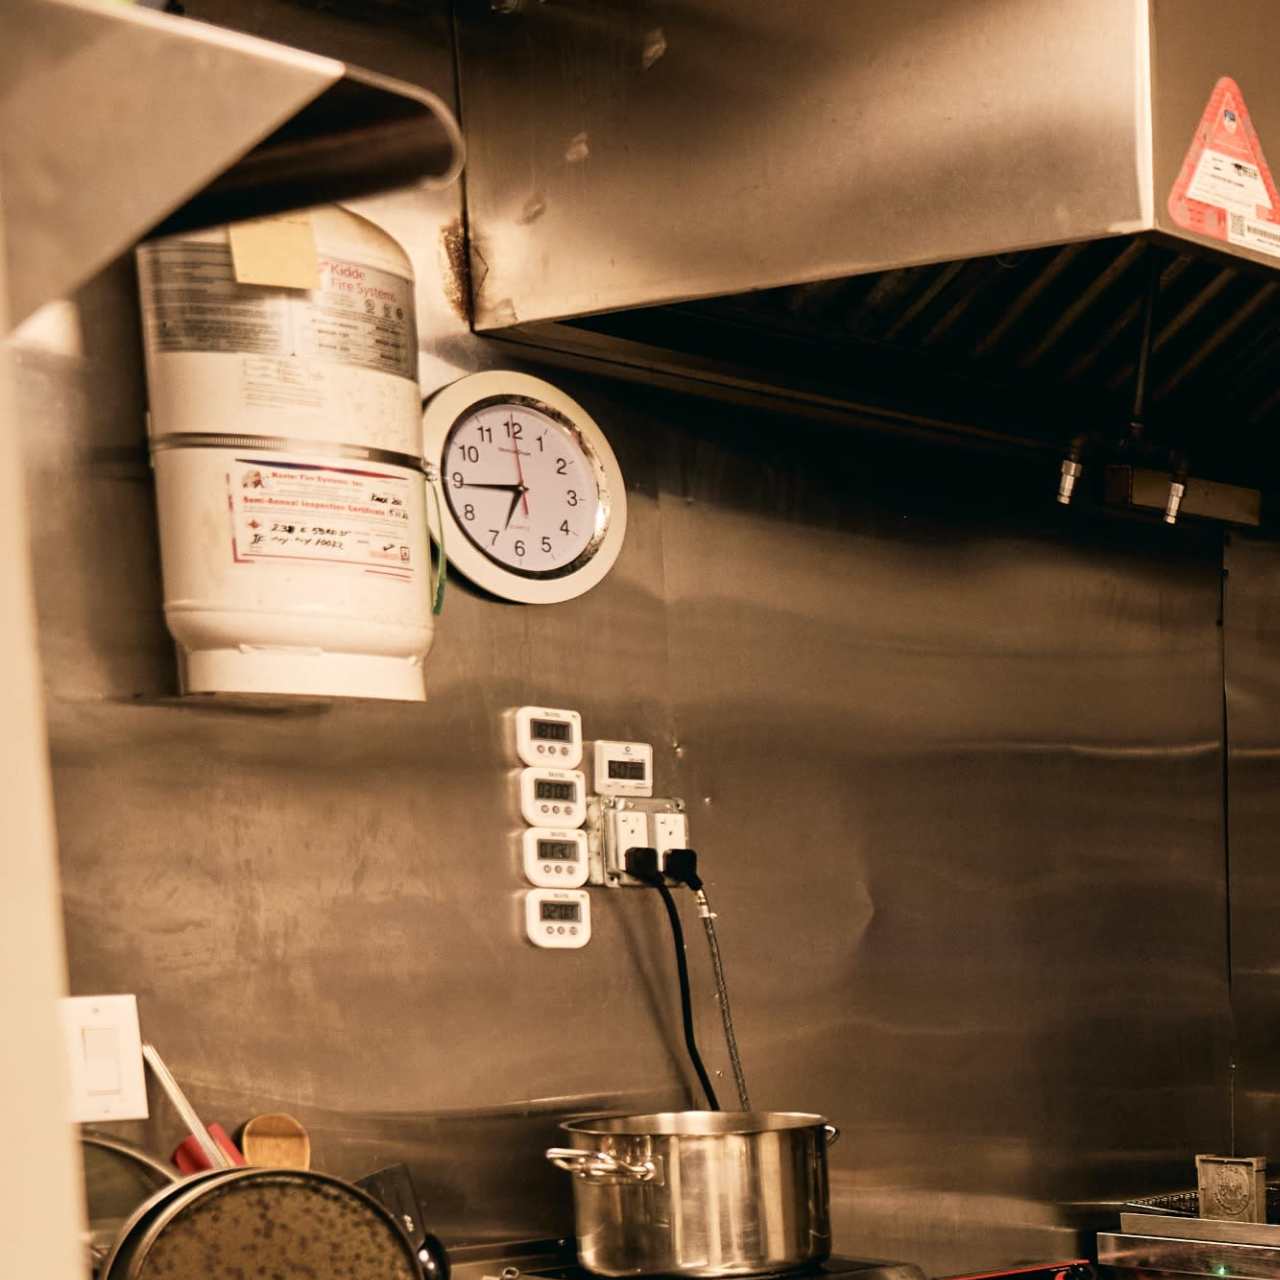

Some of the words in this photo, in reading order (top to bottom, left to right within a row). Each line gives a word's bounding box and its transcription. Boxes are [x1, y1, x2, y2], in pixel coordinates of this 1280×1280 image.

[329, 263, 366, 281] Kidde
[330, 278, 354, 292] Fire
[477, 426, 493, 444] 11
[503, 420, 523, 441] 12
[536, 436, 544, 452] 1
[458, 444, 480, 464] 10
[556, 458, 568, 475] 2
[452, 472, 464, 489] 9
[567, 490, 578, 507] 3
[463, 504, 475, 521] 8
[559, 520, 570, 536] 4
[489, 529, 500, 546] 7
[541, 536, 552, 553] 5
[514, 540, 526, 557] 6
